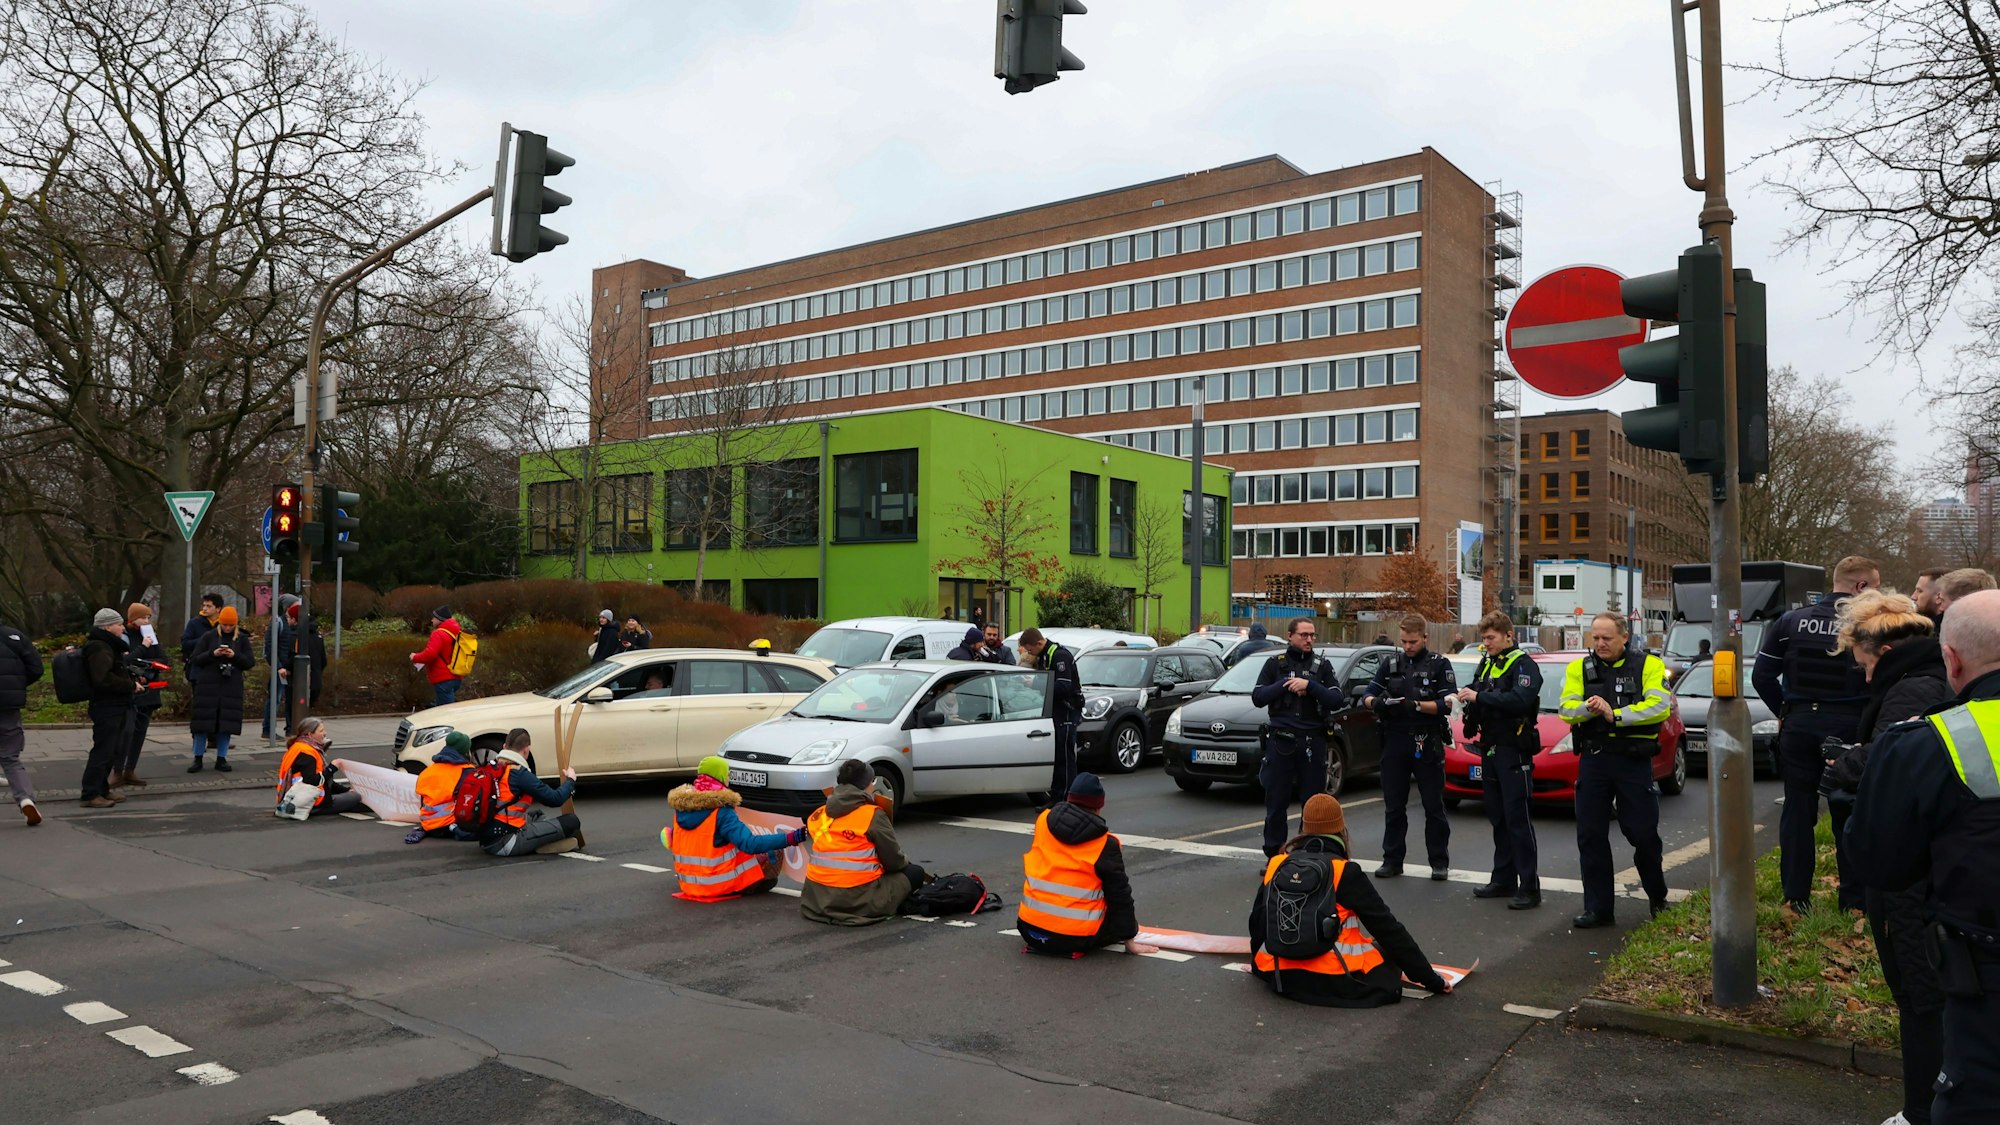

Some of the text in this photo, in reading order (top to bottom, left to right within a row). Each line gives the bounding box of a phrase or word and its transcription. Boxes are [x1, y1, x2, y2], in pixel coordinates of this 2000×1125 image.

[1196, 751, 1236, 762] K VA 2820
[741, 772, 749, 783] AC
[749, 773, 766, 785] 1415
